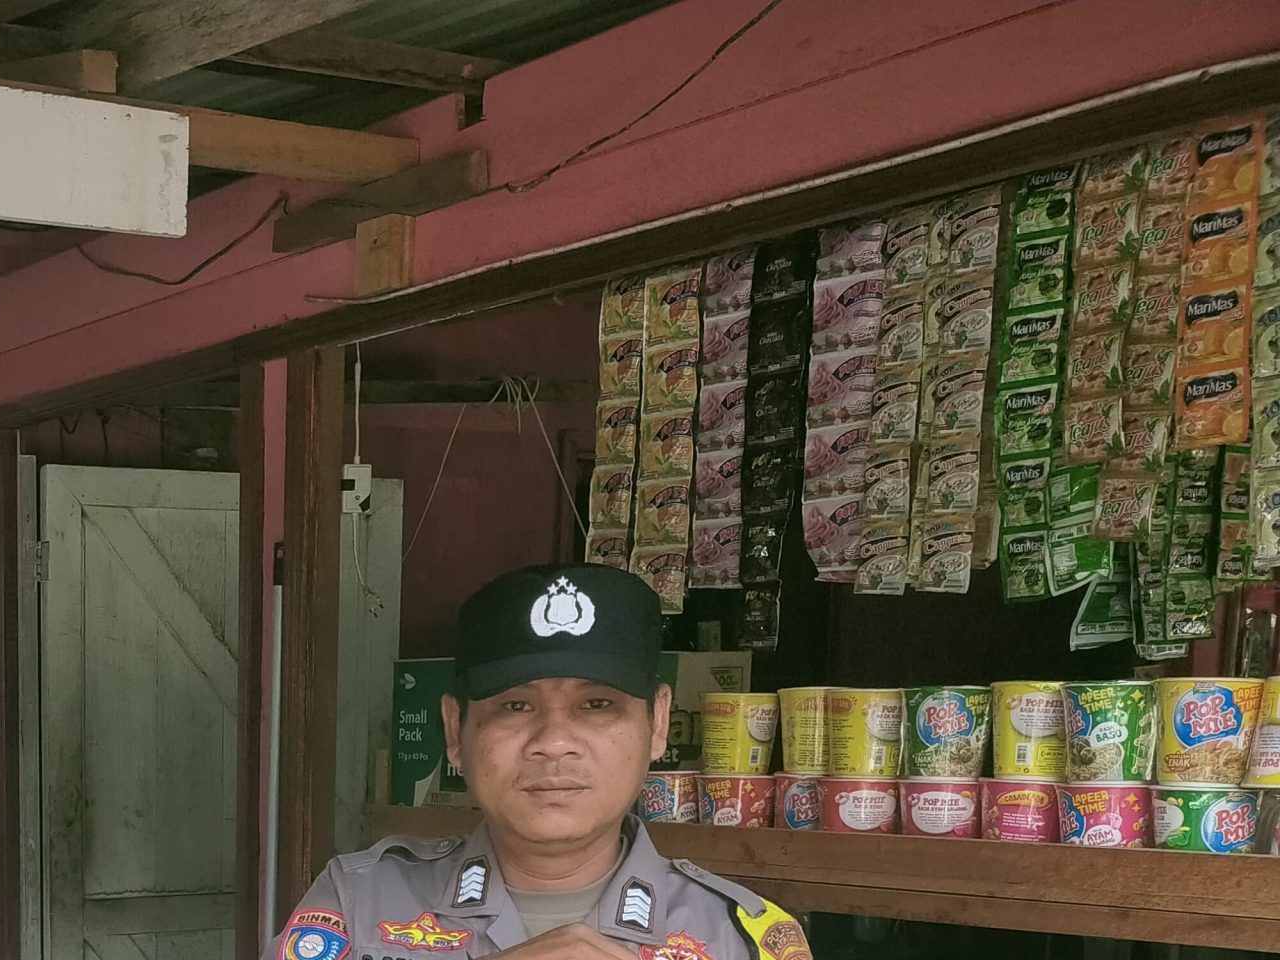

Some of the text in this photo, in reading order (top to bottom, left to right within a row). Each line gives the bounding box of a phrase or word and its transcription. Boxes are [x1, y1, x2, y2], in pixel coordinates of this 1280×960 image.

[1193, 213, 1239, 234] MariMas
[1187, 296, 1234, 317] MariMas
[1011, 320, 1051, 336] MariMas
[1186, 379, 1233, 398] MariMas
[1005, 394, 1047, 410] MariMas
[1079, 687, 1116, 705] LAPEER
[1083, 699, 1113, 714] TIME
[1183, 695, 1224, 723] POP
[399, 709, 427, 724] Small
[1190, 709, 1237, 738] MIE
[398, 727, 423, 742] Pack
[922, 797, 940, 806] POP
[1072, 790, 1110, 807] LAPEER
[1077, 800, 1107, 816] TIME
[716, 813, 739, 825] AYAM
[1215, 803, 1252, 832] POP
[1086, 830, 1114, 843] AYAM
[1223, 819, 1257, 845] MIE
